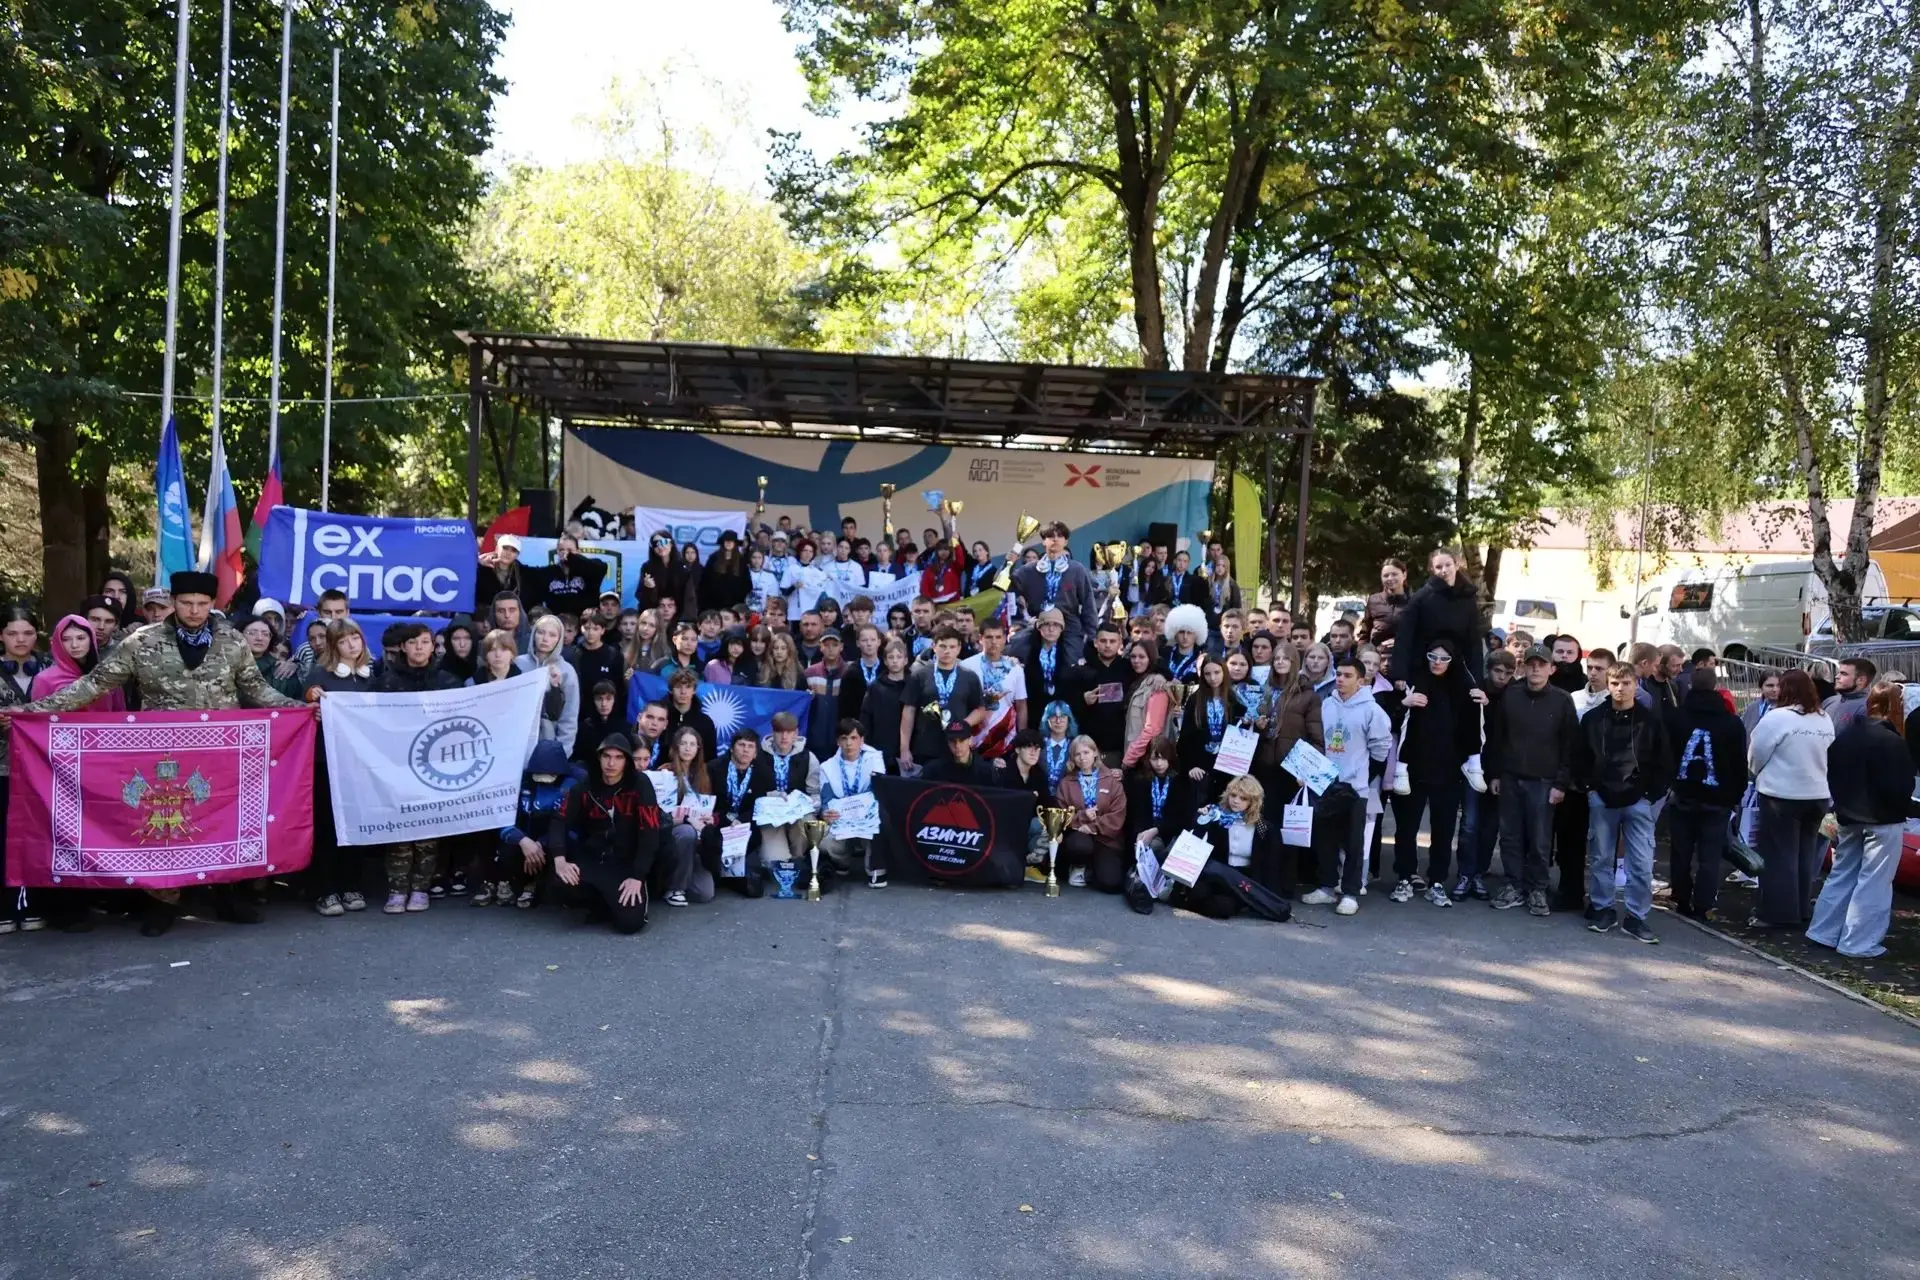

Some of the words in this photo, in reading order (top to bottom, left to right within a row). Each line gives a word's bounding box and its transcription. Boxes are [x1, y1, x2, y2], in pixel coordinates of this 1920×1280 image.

[439, 737, 493, 763] НПТ
[400, 786, 517, 814] Новороссийский
[359, 807, 494, 835] профессиональный
[916, 826, 985, 846] АЗИМУТ
